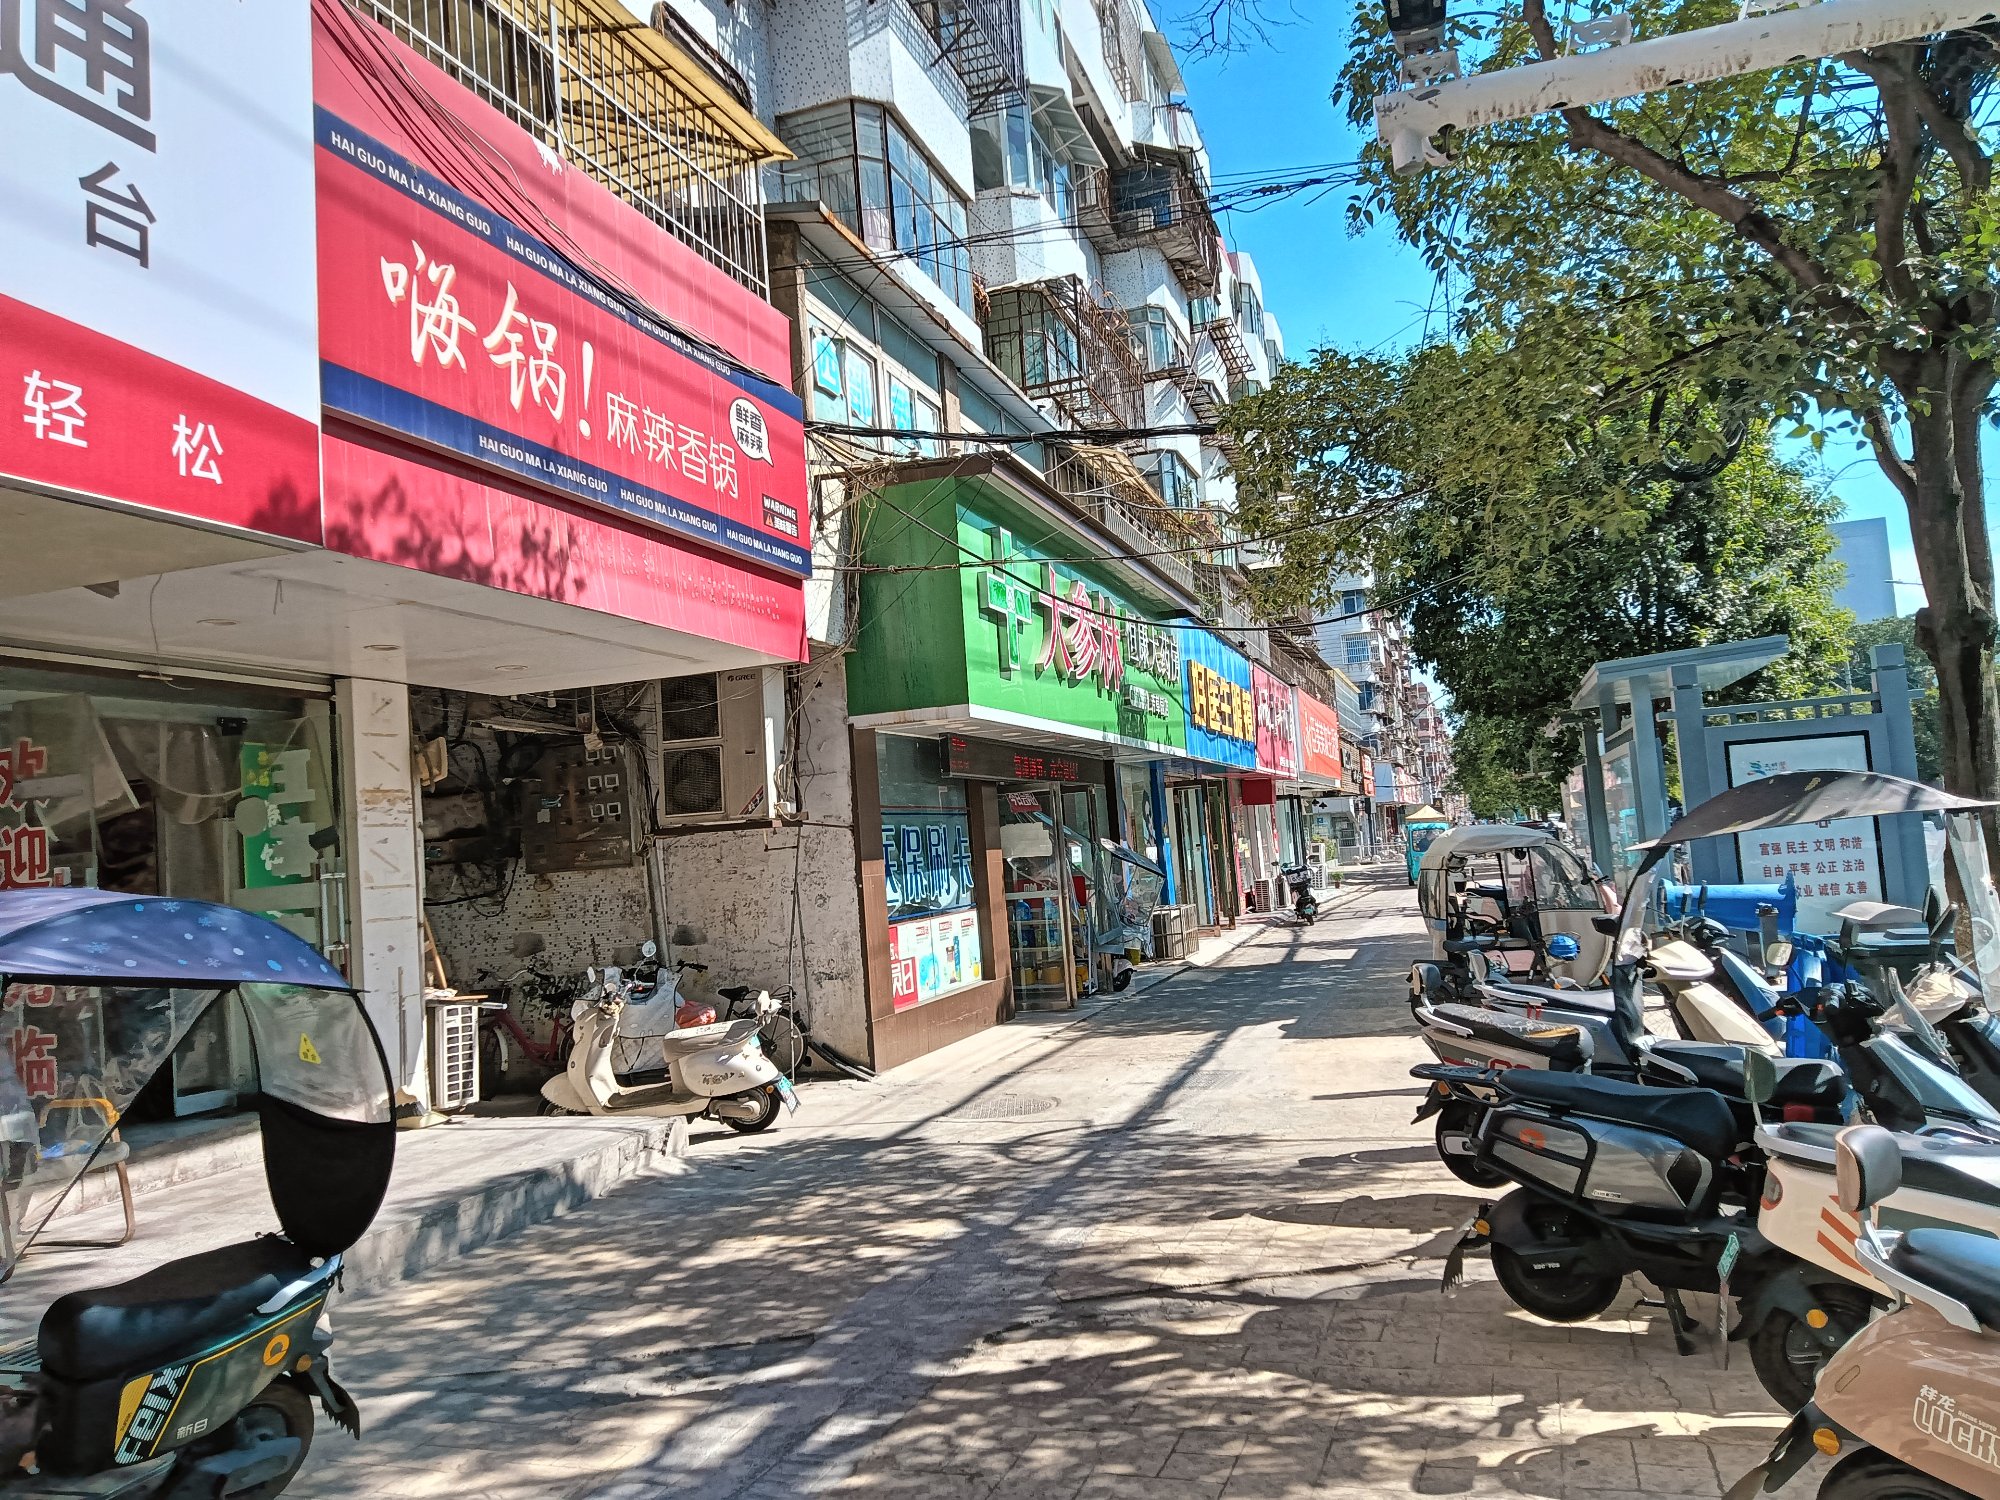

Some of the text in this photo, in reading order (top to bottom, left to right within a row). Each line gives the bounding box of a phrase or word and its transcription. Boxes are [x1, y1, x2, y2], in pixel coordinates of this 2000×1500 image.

[331, 131, 490, 235] HAI GUO MA LA XIANG GUO
[79, 161, 157, 269] 台
[507, 236, 626, 315] HAI GUO MA LA XIANG GUO
[653, 324, 669, 341] GUO
[671, 335, 682, 350] MA
[684, 341, 693, 353] LA
[716, 360, 730, 376] GUO
[735, 403, 762, 433] 鲜香
[605, 391, 739, 499] 麻辣香锅
[736, 425, 764, 454] 麻辣
[479, 435, 607, 493] HAI GUO MA LA XIANG GUO
[621, 489, 717, 534] HAI GUO MA LA XIANG GUO
[764, 496, 797, 520] WARNING
[727, 528, 802, 564] HAI GUO MA LA XIANG GUO
[735, 673, 756, 682] GREE
[1759, 836, 1862, 856] 富强 民主 文明 和谐
[1763, 859, 1865, 878] 自由 平等 公正 法治
[1818, 882, 1841, 897] 诚信
[1845, 881, 1867, 894] 友善
[1920, 1384, 1956, 1412] 祥龙
[176, 1418, 208, 1440] 新日
